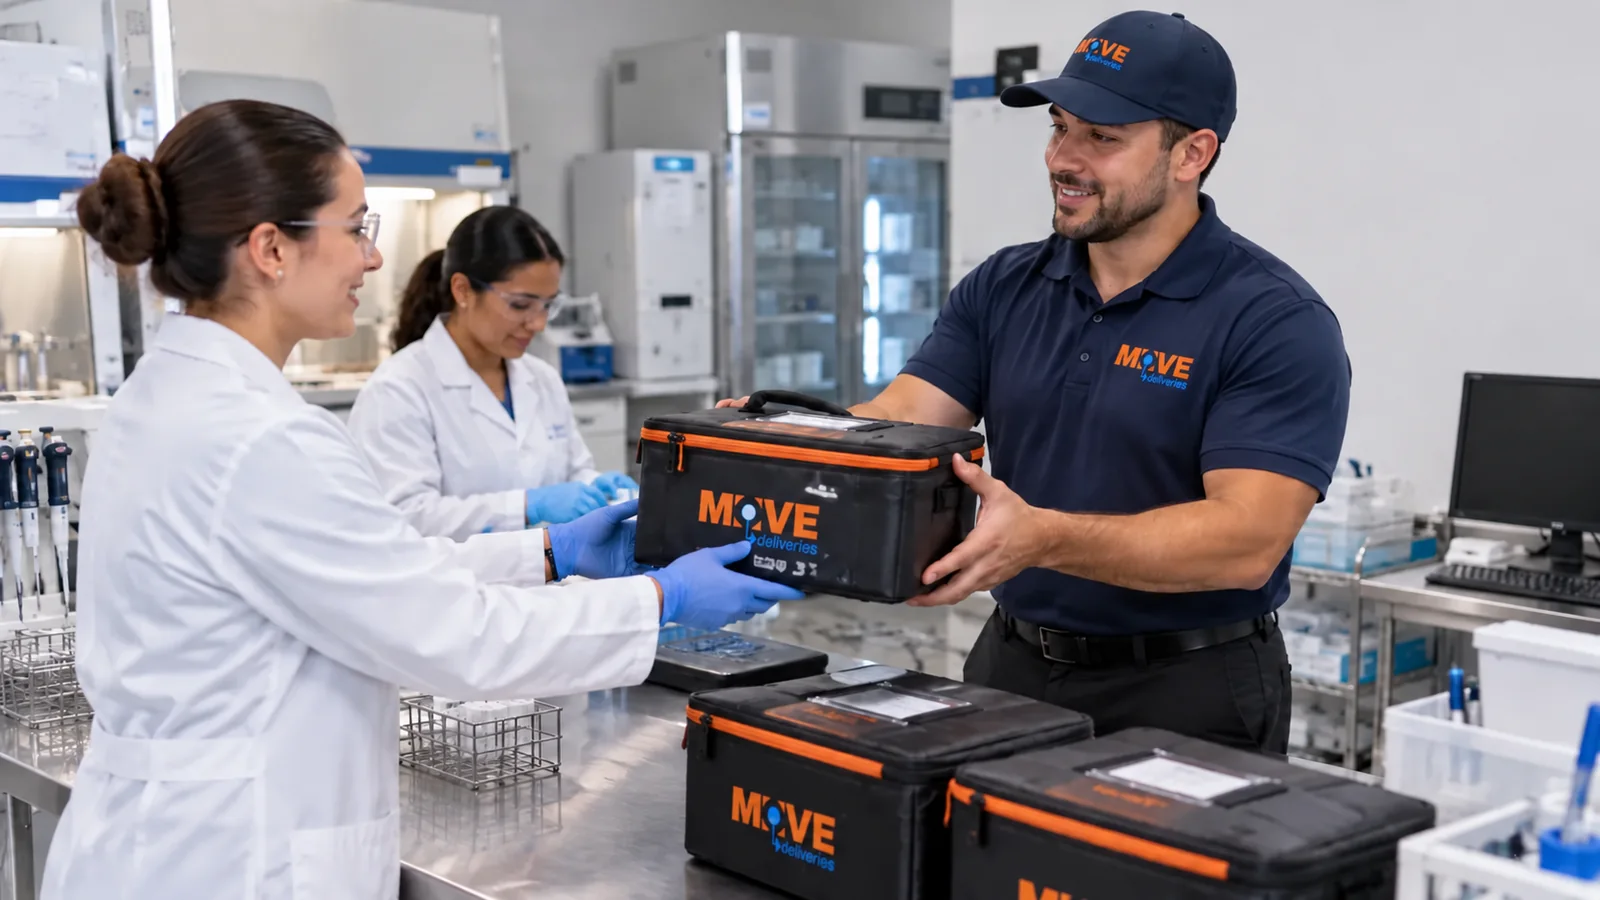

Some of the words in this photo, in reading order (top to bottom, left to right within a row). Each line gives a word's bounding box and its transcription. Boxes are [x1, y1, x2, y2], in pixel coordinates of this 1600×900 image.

[1114, 343, 1194, 380] MOVE
[1147, 373, 1188, 390] deliveries
[698, 489, 820, 540] MOVE
[756, 533, 818, 555] deliveries
[731, 785, 836, 856] MOVE
[780, 842, 835, 872] deliveries
